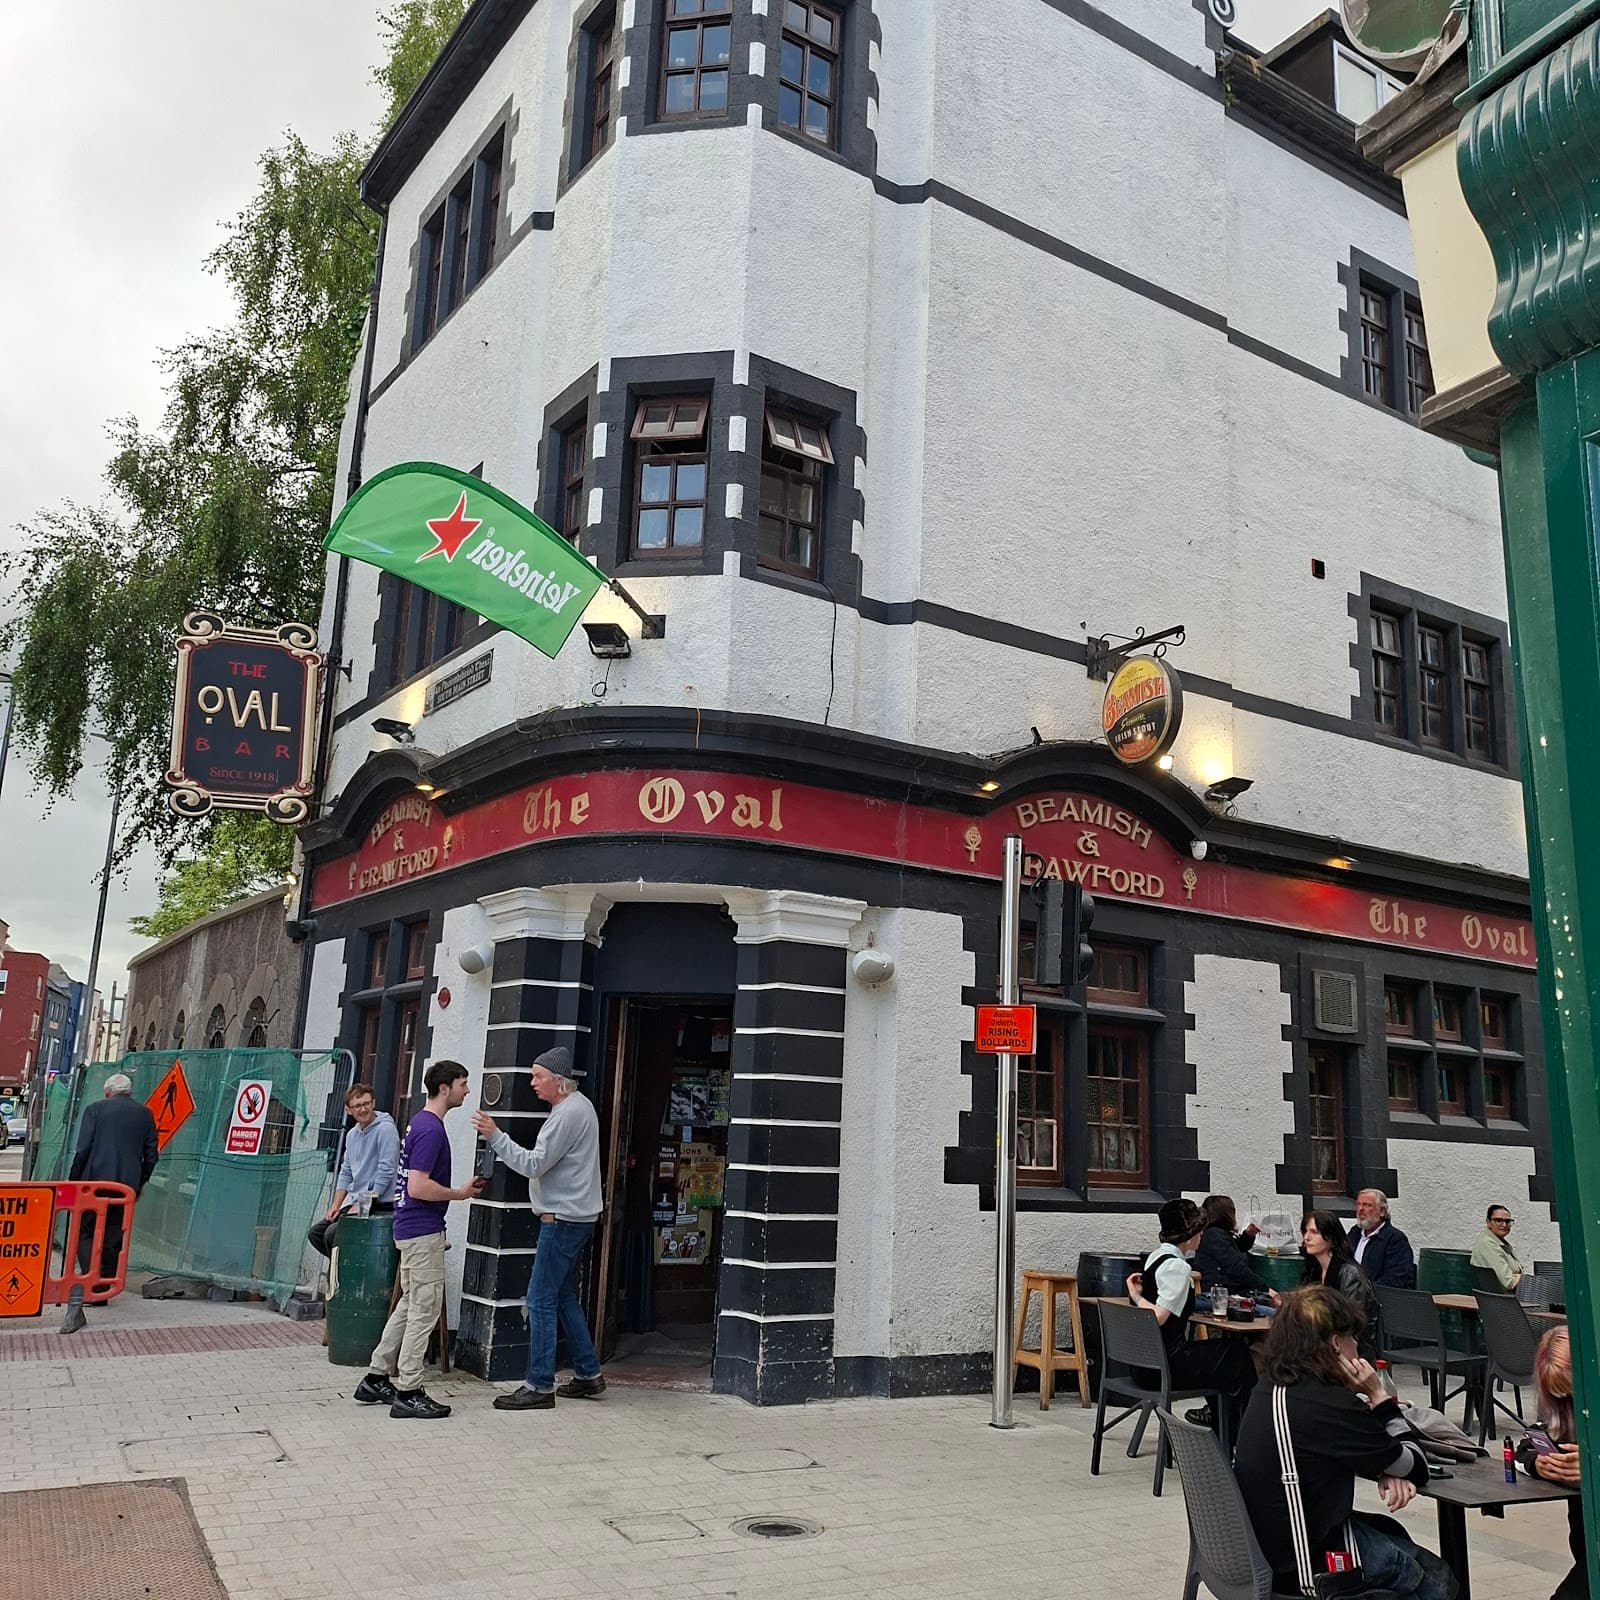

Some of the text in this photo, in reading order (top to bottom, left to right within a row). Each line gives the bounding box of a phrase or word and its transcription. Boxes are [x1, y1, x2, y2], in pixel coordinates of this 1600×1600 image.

[228, 661, 268, 678] THE
[198, 685, 291, 732] OVAL
[1104, 676, 1166, 730] BEAMISH
[1115, 722, 1156, 743] IRISH STOUT
[194, 738, 290, 758] BAR
[248, 770, 276, 783] 1918
[522, 776, 783, 834] The Oval
[371, 799, 432, 847] BEAMISH
[1015, 798, 1153, 849] BEAMISH
[394, 828, 404, 852] &
[1076, 830, 1101, 857] &
[359, 846, 438, 890] CRAWFORD
[1024, 856, 1165, 898] RAWFORD
[1369, 898, 1529, 956] The Oval
[981, 1038, 1027, 1048] BOLLARDS
[988, 1028, 1019, 1037] RISING
[231, 1140, 255, 1148] Keep Out
[232, 1130, 258, 1139] DANGER
[0, 1220, 15, 1238] D
